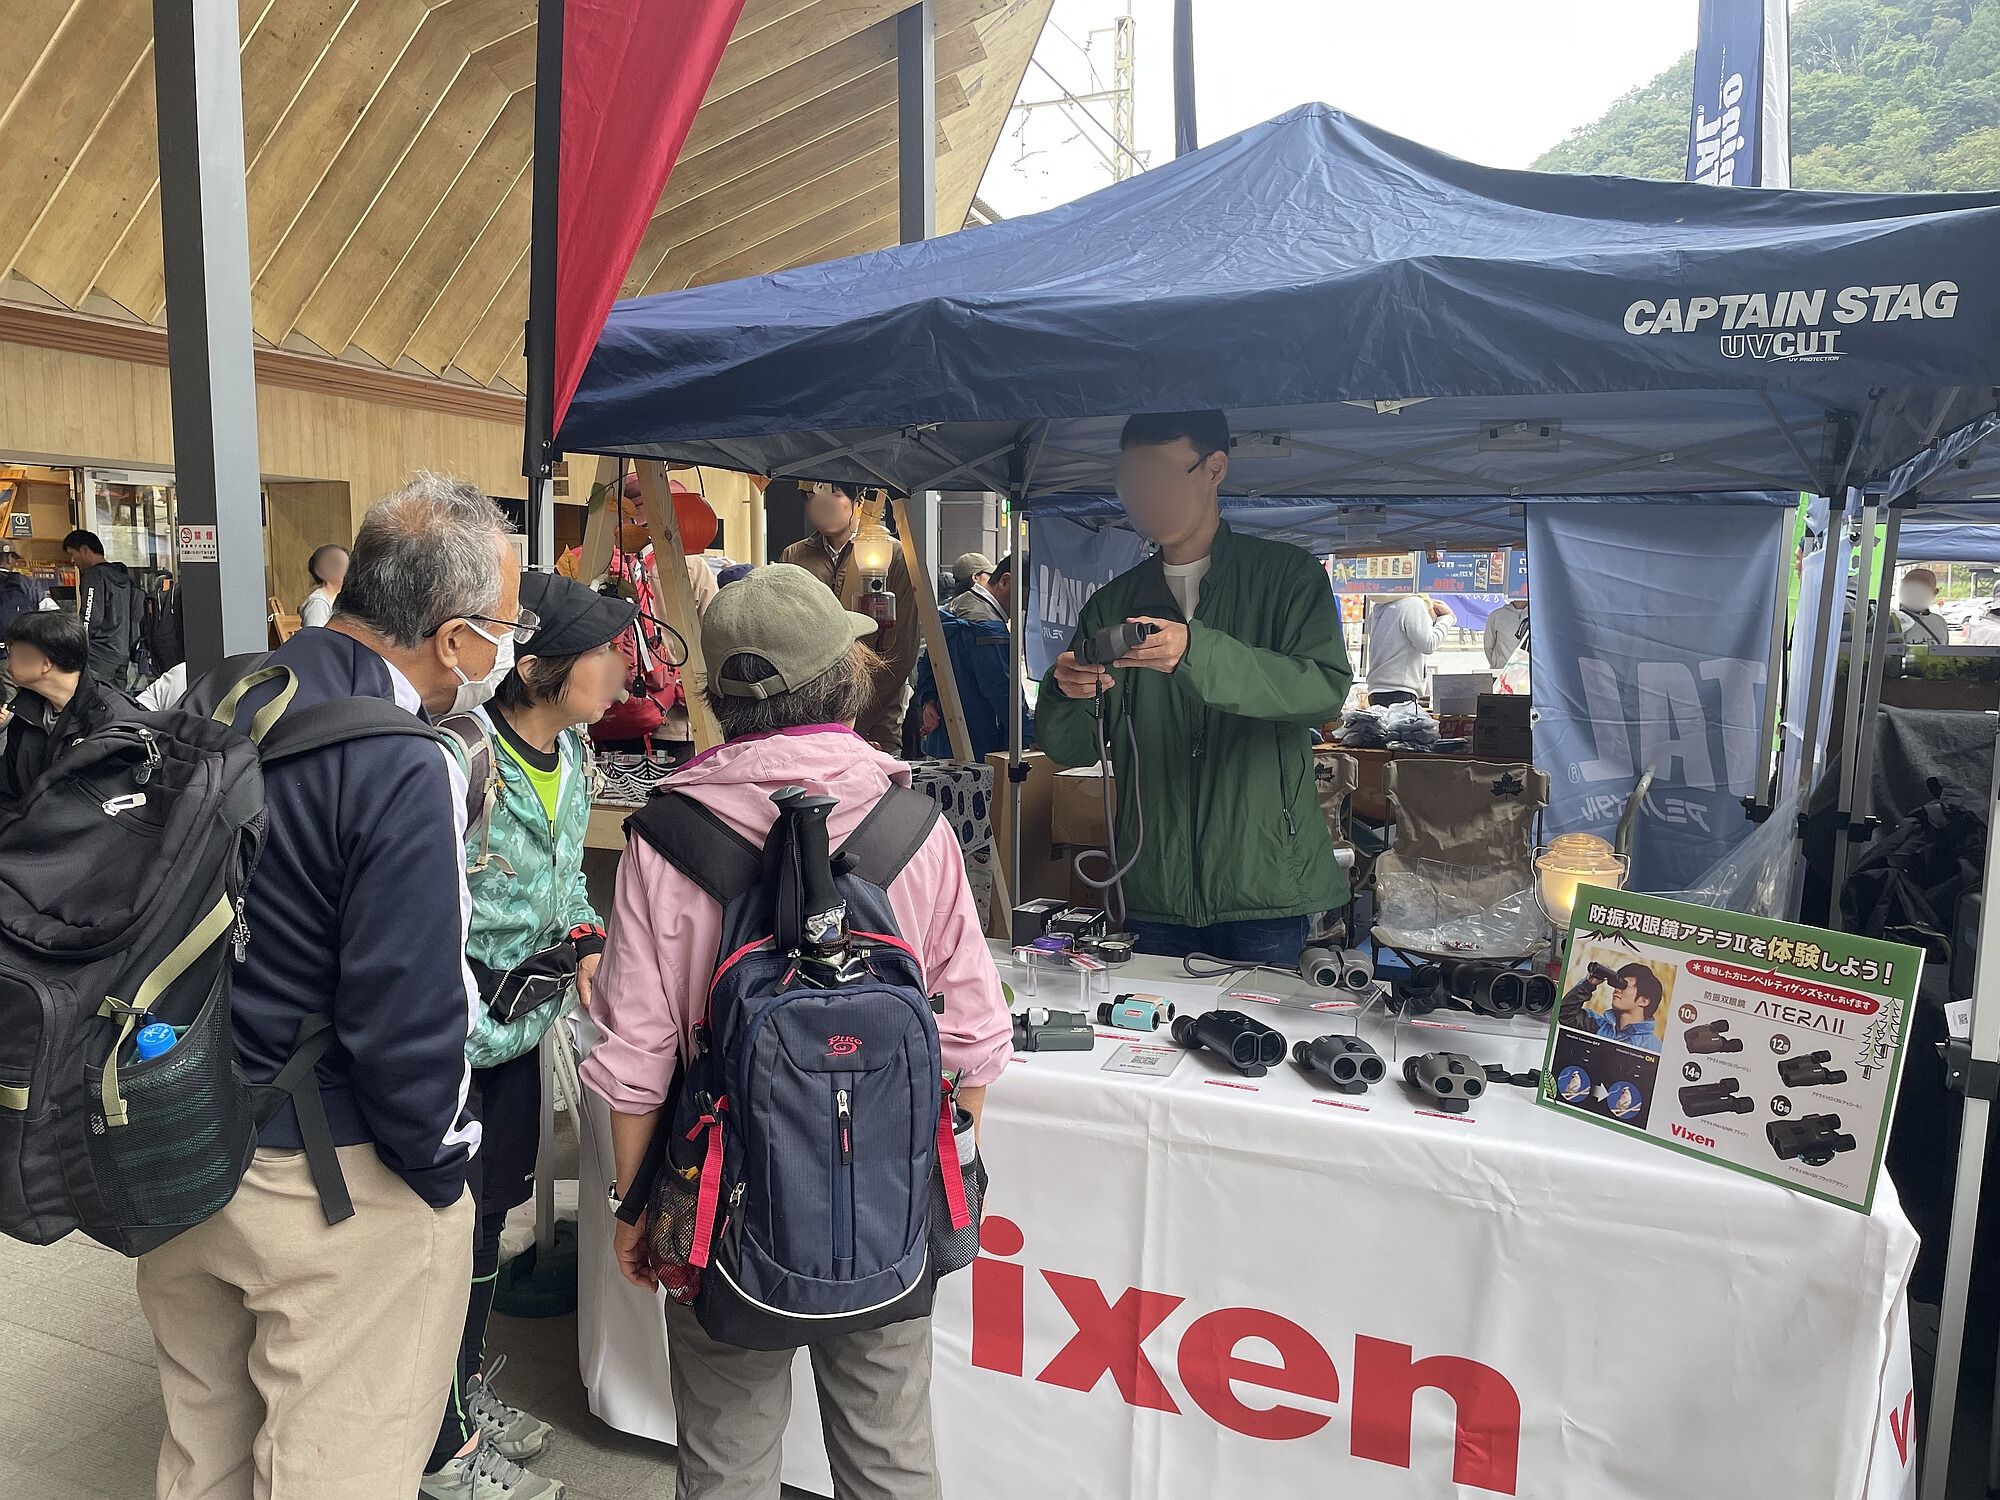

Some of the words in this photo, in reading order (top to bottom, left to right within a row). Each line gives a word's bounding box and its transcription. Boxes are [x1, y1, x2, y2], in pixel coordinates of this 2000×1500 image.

[1623, 289, 1826, 335] CAPTAIN
[1832, 280, 1959, 324] STAG
[84, 587, 95, 622] ARMOUR
[1644, 1055, 1655, 1063] ON
[1670, 1122, 1716, 1148] Vixen
[971, 1215, 1521, 1496] ixen
[1889, 1387, 1917, 1469] V
